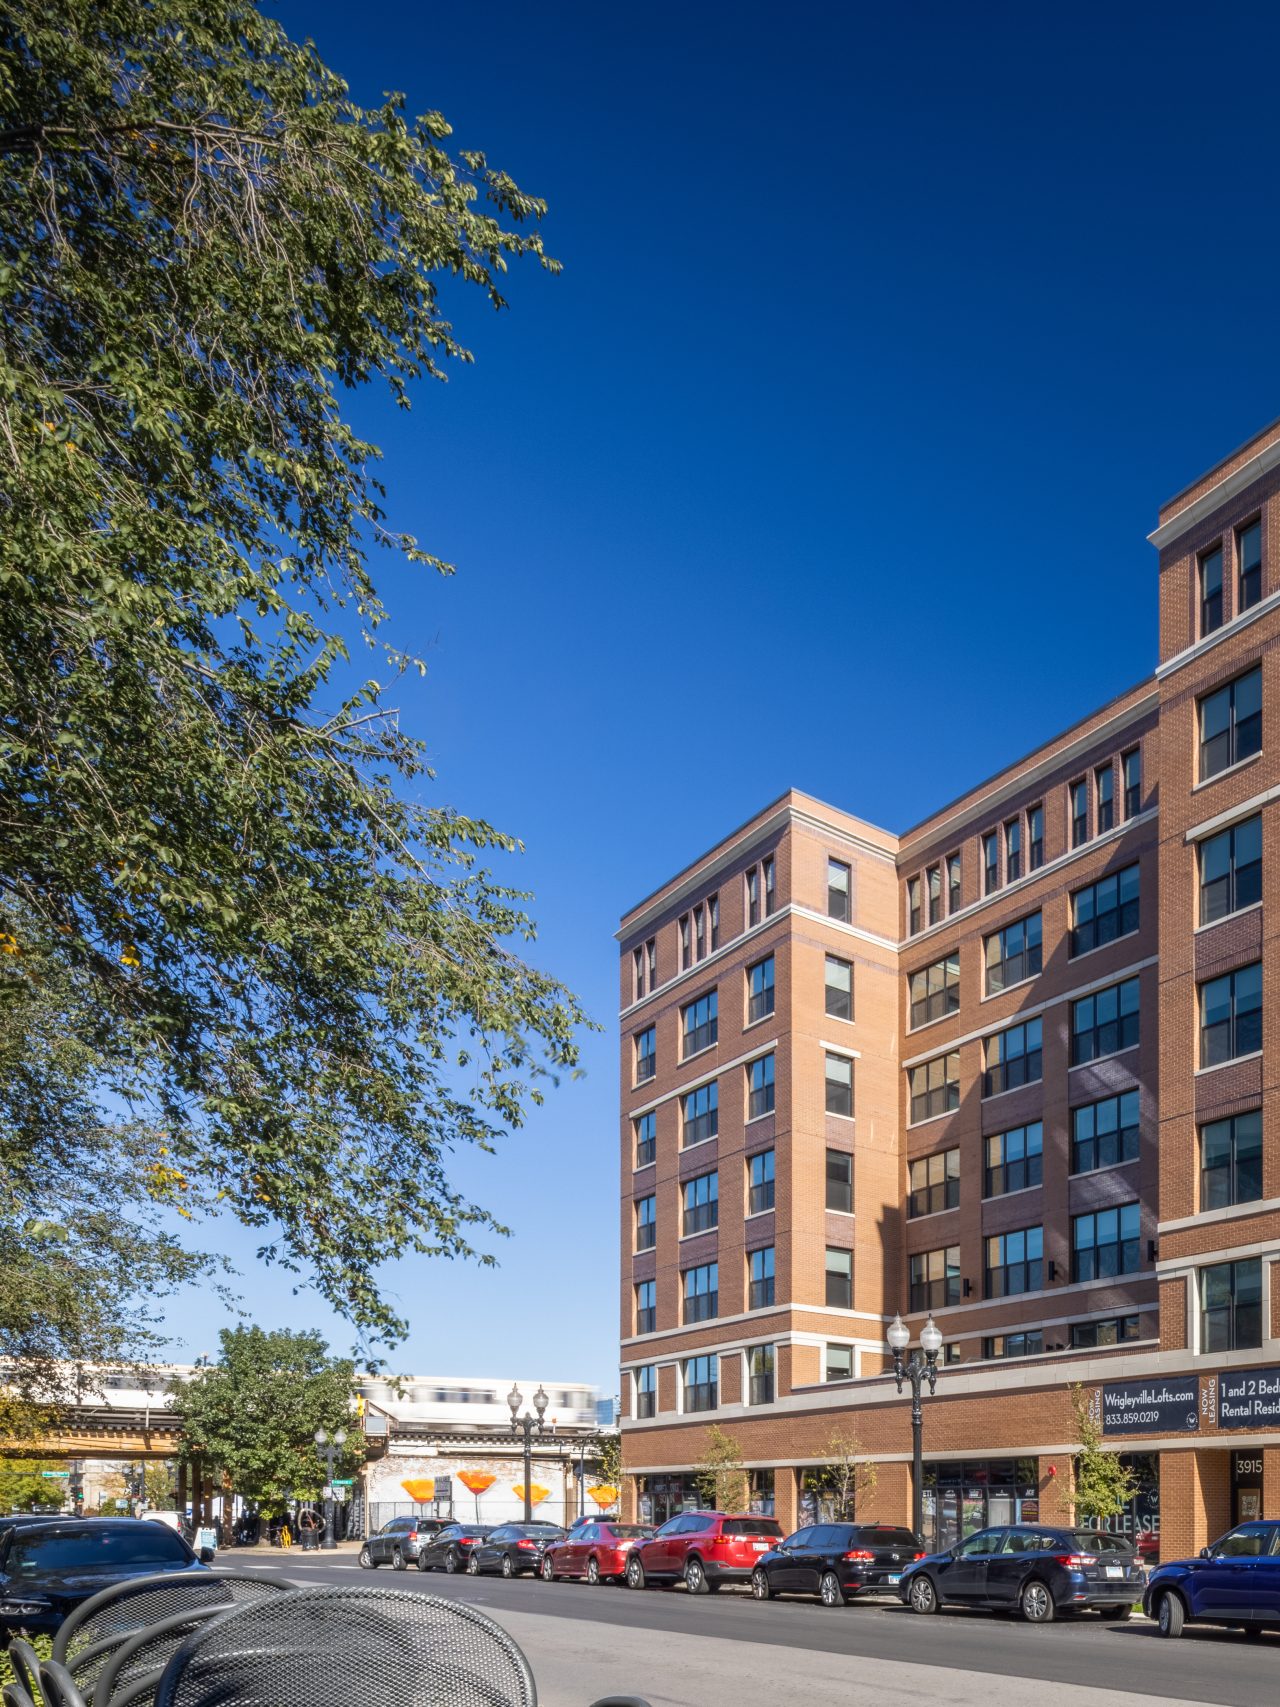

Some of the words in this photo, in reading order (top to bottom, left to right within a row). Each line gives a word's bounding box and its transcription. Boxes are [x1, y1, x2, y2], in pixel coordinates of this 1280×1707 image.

[1221, 1383, 1226, 1398] 1
[1228, 1381, 1246, 1397] and
[1248, 1380, 1256, 1395] 2
[1104, 1387, 1194, 1410] WrigleyvilleLofts.com
[1208, 1379, 1216, 1423] LEASING
[1105, 1410, 1160, 1425] 833.859.0219
[1221, 1400, 1252, 1418] Rental
[1236, 1460, 1263, 1473] 3915
[1115, 1513, 1160, 1534] LEASE
